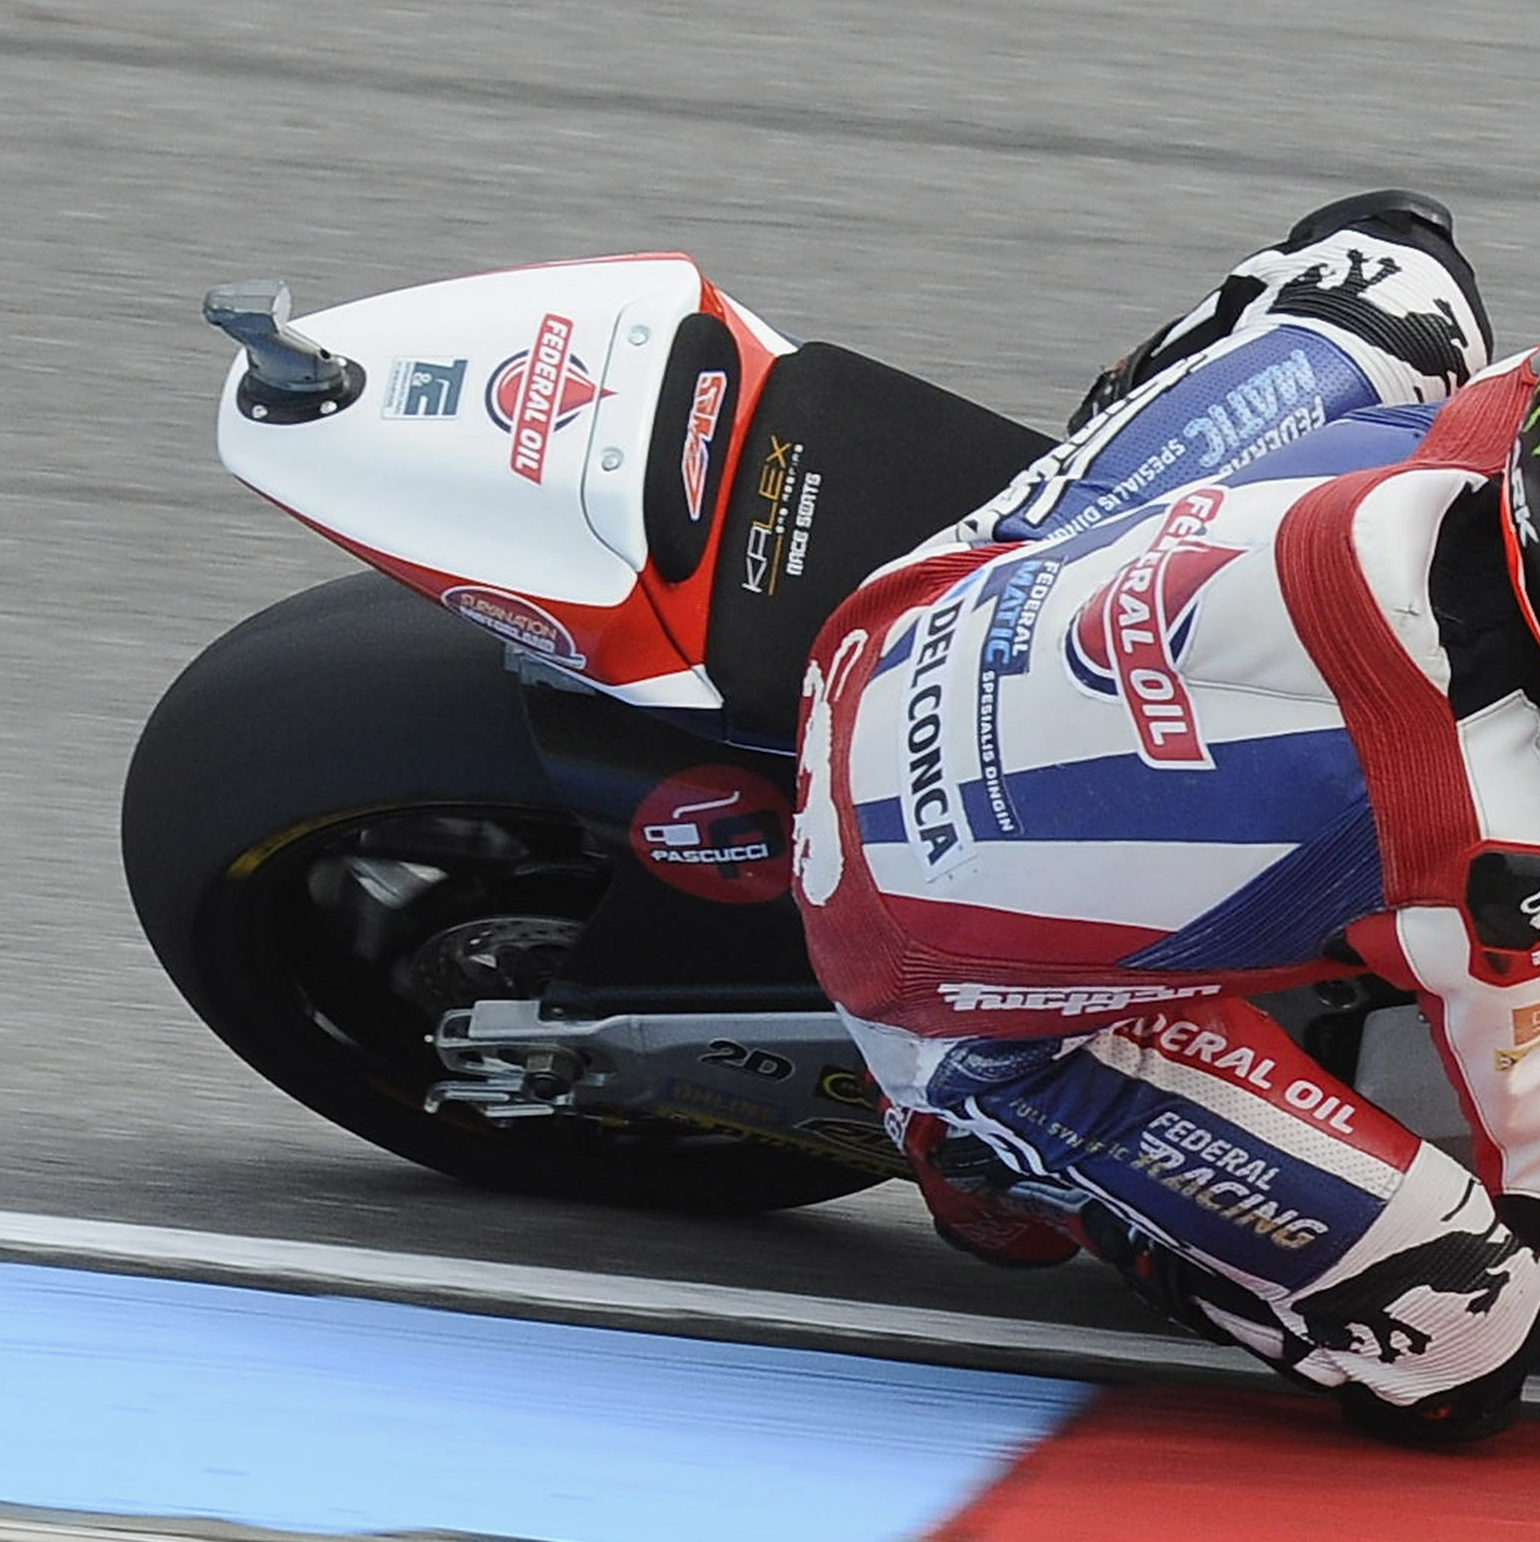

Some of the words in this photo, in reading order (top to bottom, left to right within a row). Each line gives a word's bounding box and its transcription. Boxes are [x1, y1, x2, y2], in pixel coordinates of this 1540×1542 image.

[523, 319, 569, 424] FEDERAL
[515, 427, 543, 472] OIL
[1098, 438, 1187, 512] SPESIALIS
[741, 434, 792, 593] KALEX
[984, 560, 1043, 664] MATIC
[1013, 560, 1059, 657] FEDERAL
[980, 669, 996, 763] SPESIALIS
[1129, 668, 1188, 747] OIL
[985, 768, 1014, 832] DINGIN
[650, 844, 770, 864] PASCUCCI
[698, 1037, 796, 1083] 2D
[1133, 1013, 1276, 1090] DERAL
[1283, 1079, 1355, 1135] OIL
[1138, 1133, 1331, 1251] RACING
[1147, 1111, 1281, 1193] FEDERAL
